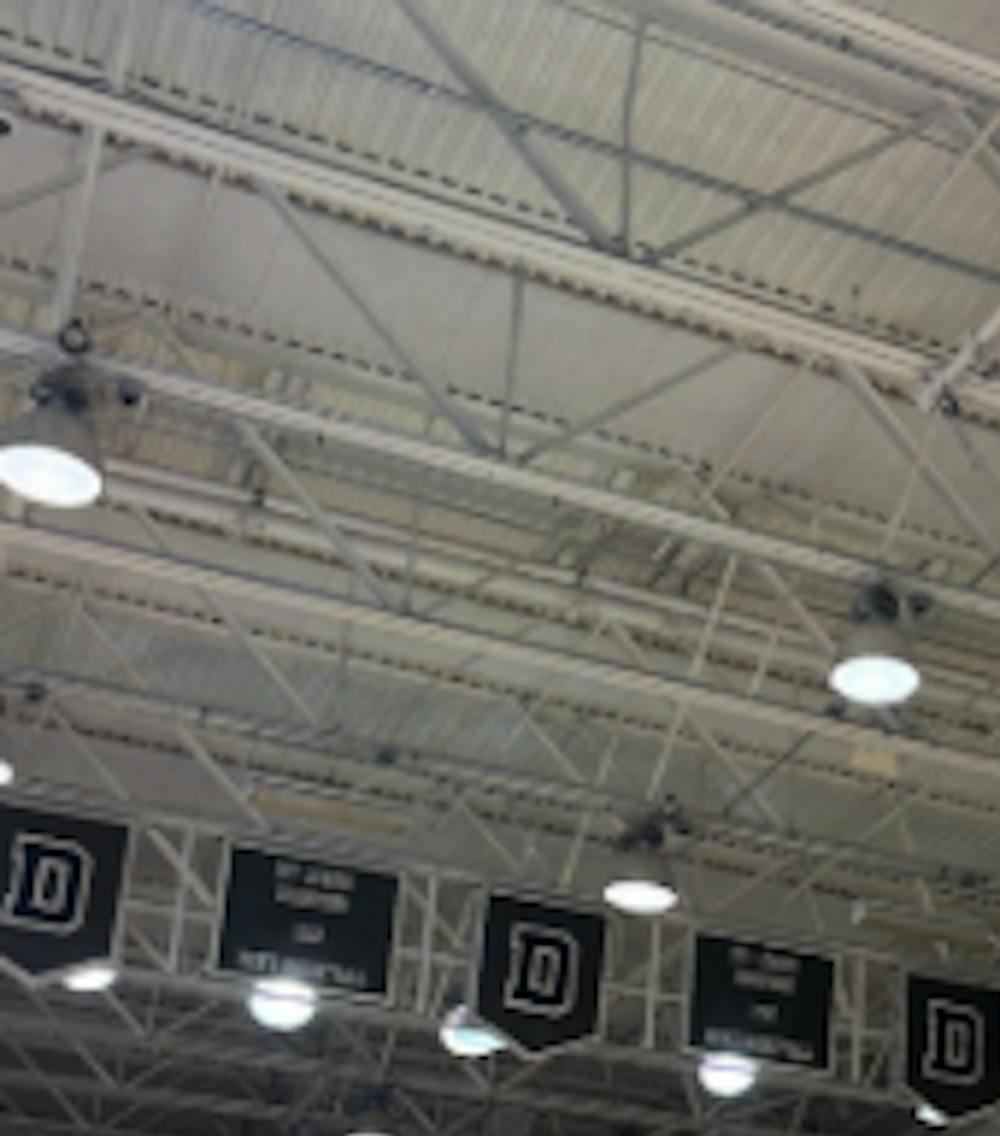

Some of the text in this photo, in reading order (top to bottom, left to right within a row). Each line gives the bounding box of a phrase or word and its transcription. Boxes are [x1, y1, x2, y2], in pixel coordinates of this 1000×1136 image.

[0, 833, 96, 936] D
[504, 921, 579, 1020] D
[921, 997, 984, 1084] D
